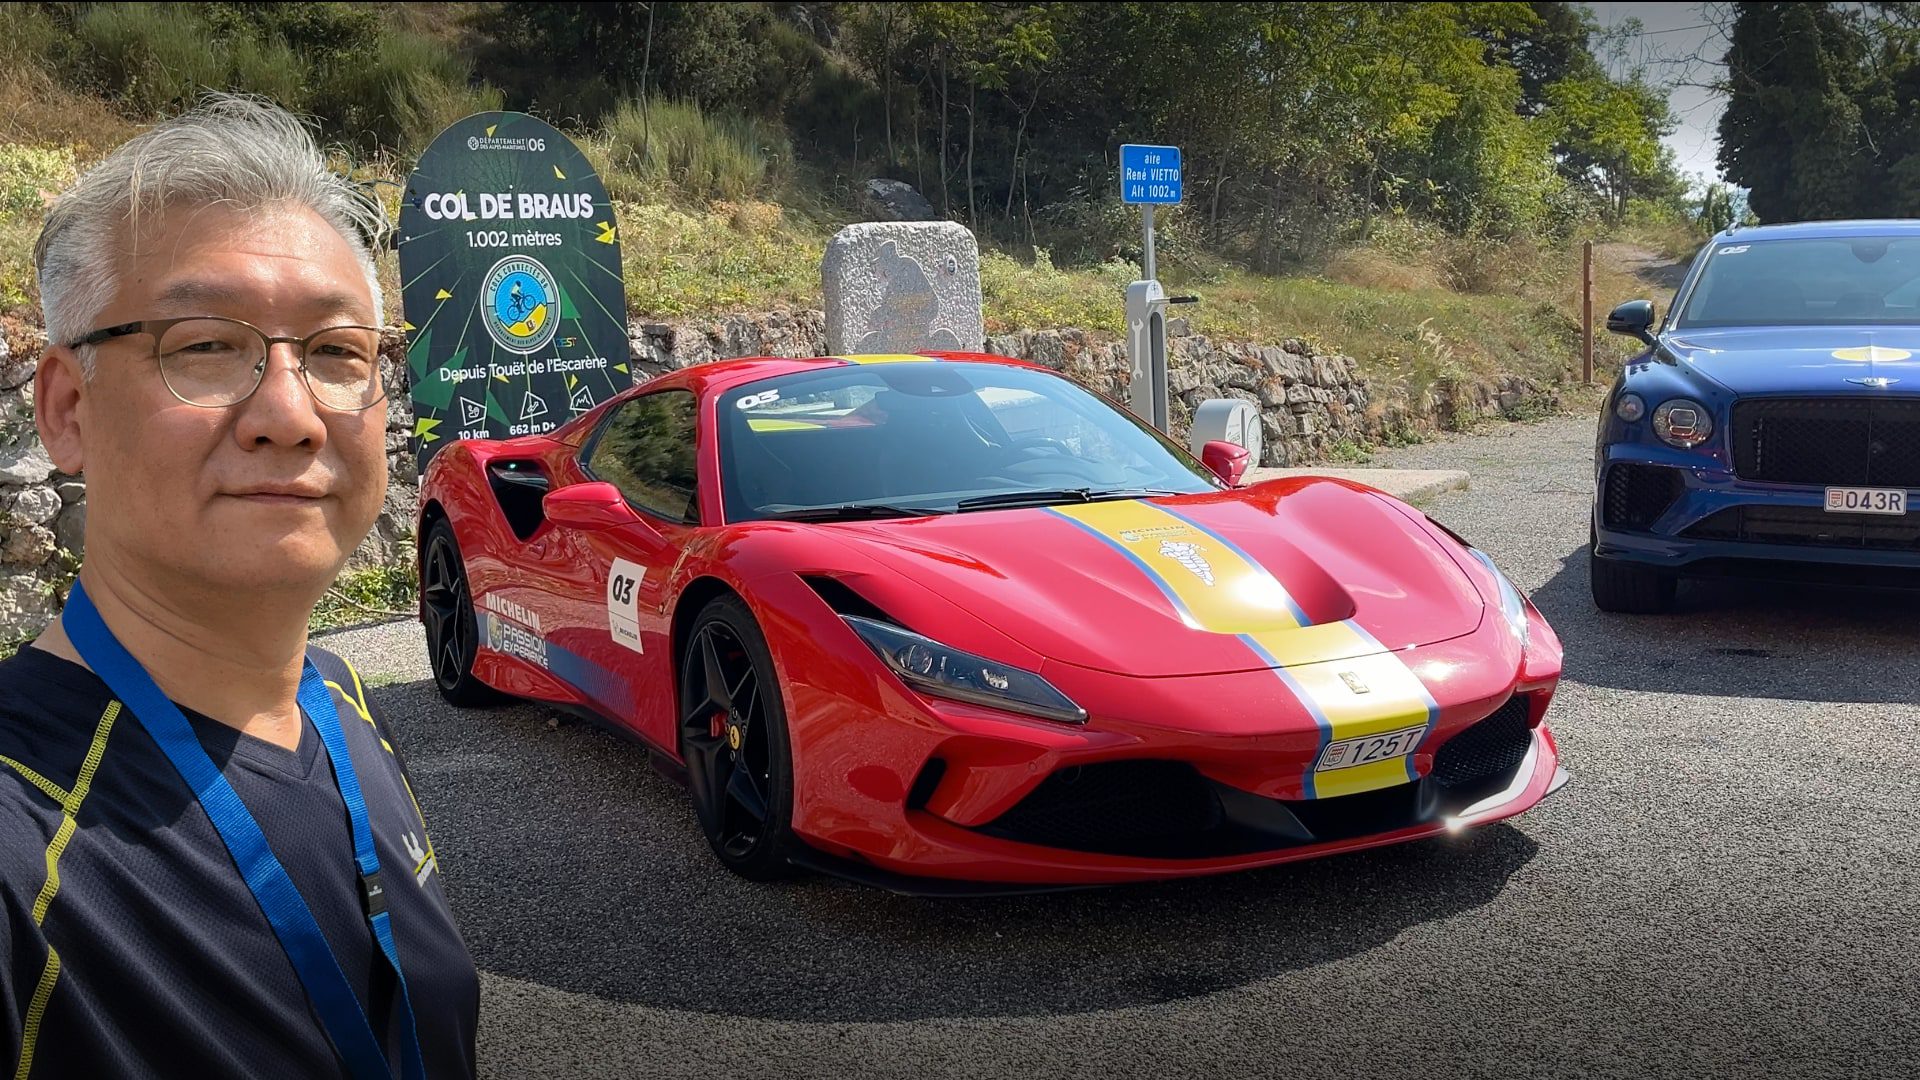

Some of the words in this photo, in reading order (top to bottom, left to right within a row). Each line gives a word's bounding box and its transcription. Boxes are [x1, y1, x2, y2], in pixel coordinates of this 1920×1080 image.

[529, 138, 546, 151] 06
[1144, 151, 1161, 165] aire
[1126, 167, 1147, 181] René
[1150, 168, 1179, 182] VIETTO
[1131, 184, 1145, 198] Alt
[1149, 184, 1169, 198] 1002
[424, 193, 476, 220] COL
[480, 193, 514, 219] DE
[518, 193, 594, 219] BRAUS
[466, 231, 509, 248] 1.002
[512, 229, 562, 247] mètres
[1718, 245, 1751, 255] 05
[440, 365, 487, 383] Depuis
[489, 362, 526, 378] Touët
[528, 359, 545, 373] de
[736, 388, 780, 410] 03
[458, 430, 471, 440] 10
[473, 429, 490, 439] km
[509, 425, 529, 436] 662
[531, 425, 540, 433] m
[542, 421, 556, 432] D+
[1846, 491, 1902, 511] 043R
[612, 574, 635, 605] 03
[485, 591, 542, 632] MICHELIN
[503, 622, 547, 657] PASSION
